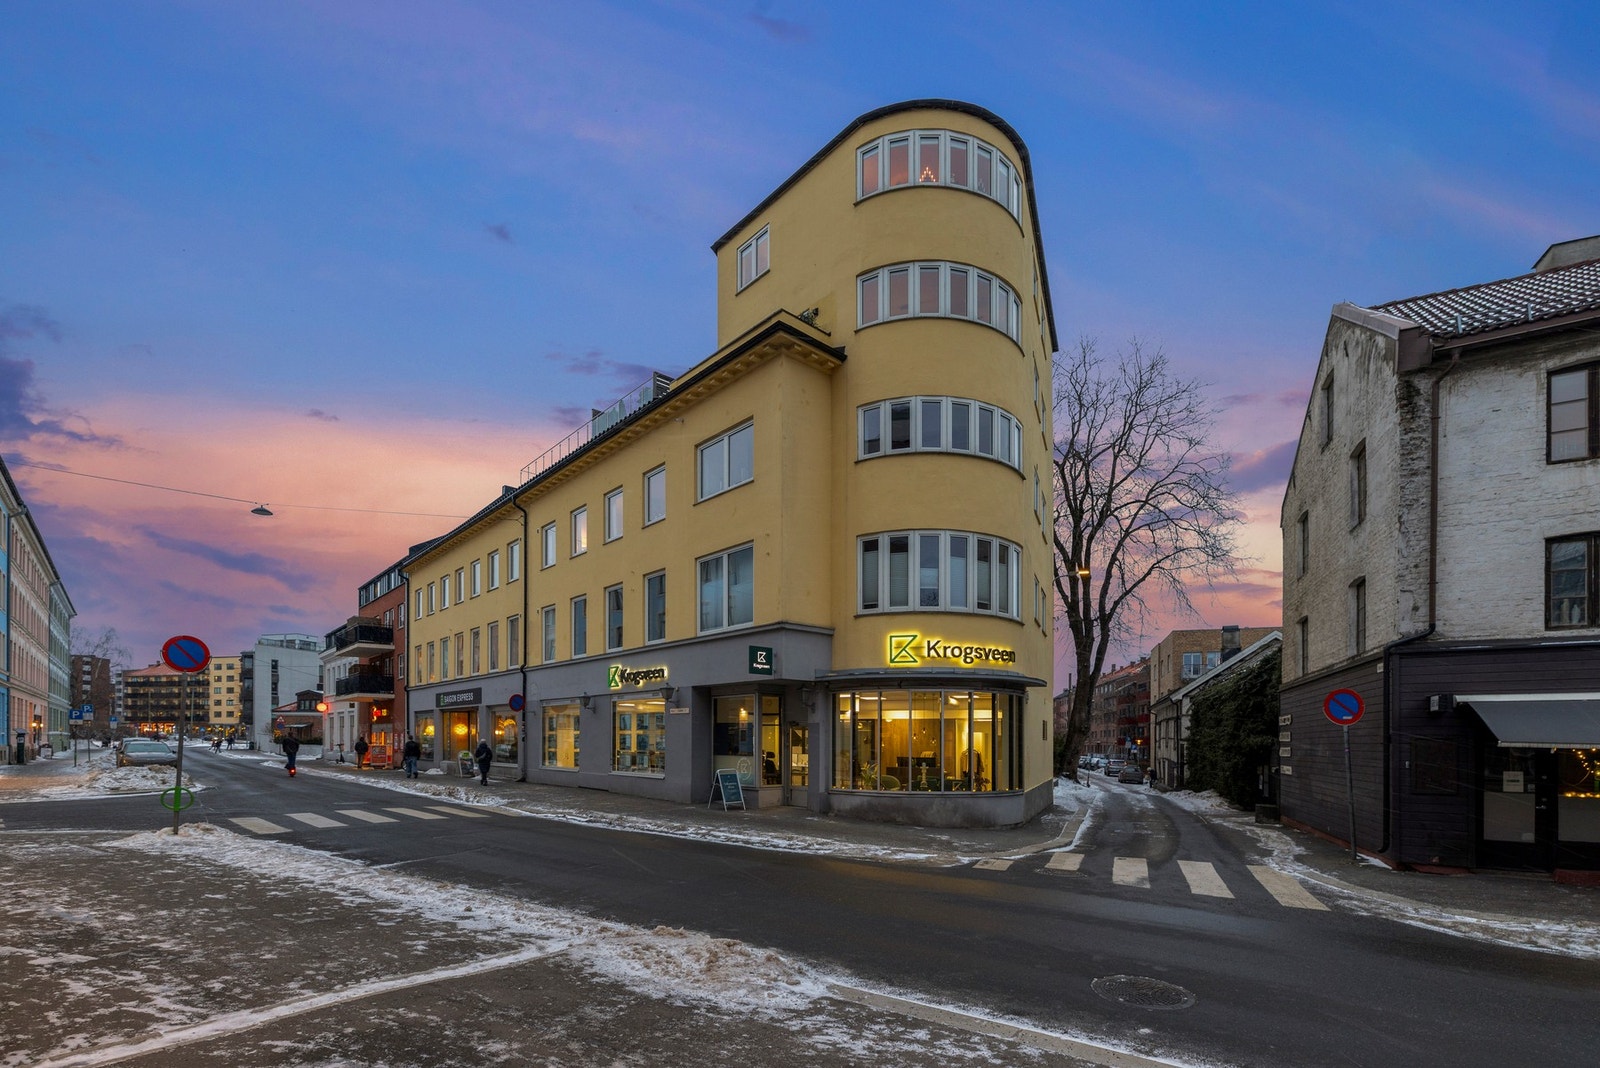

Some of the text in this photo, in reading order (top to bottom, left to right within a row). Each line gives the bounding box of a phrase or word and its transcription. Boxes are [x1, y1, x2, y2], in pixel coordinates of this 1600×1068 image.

[926, 639, 1016, 665] Krogsveen
[620, 668, 665, 686] Krogsveen
[444, 692, 474, 703] SAIGON EXPRESS
[72, 710, 80, 719] P
